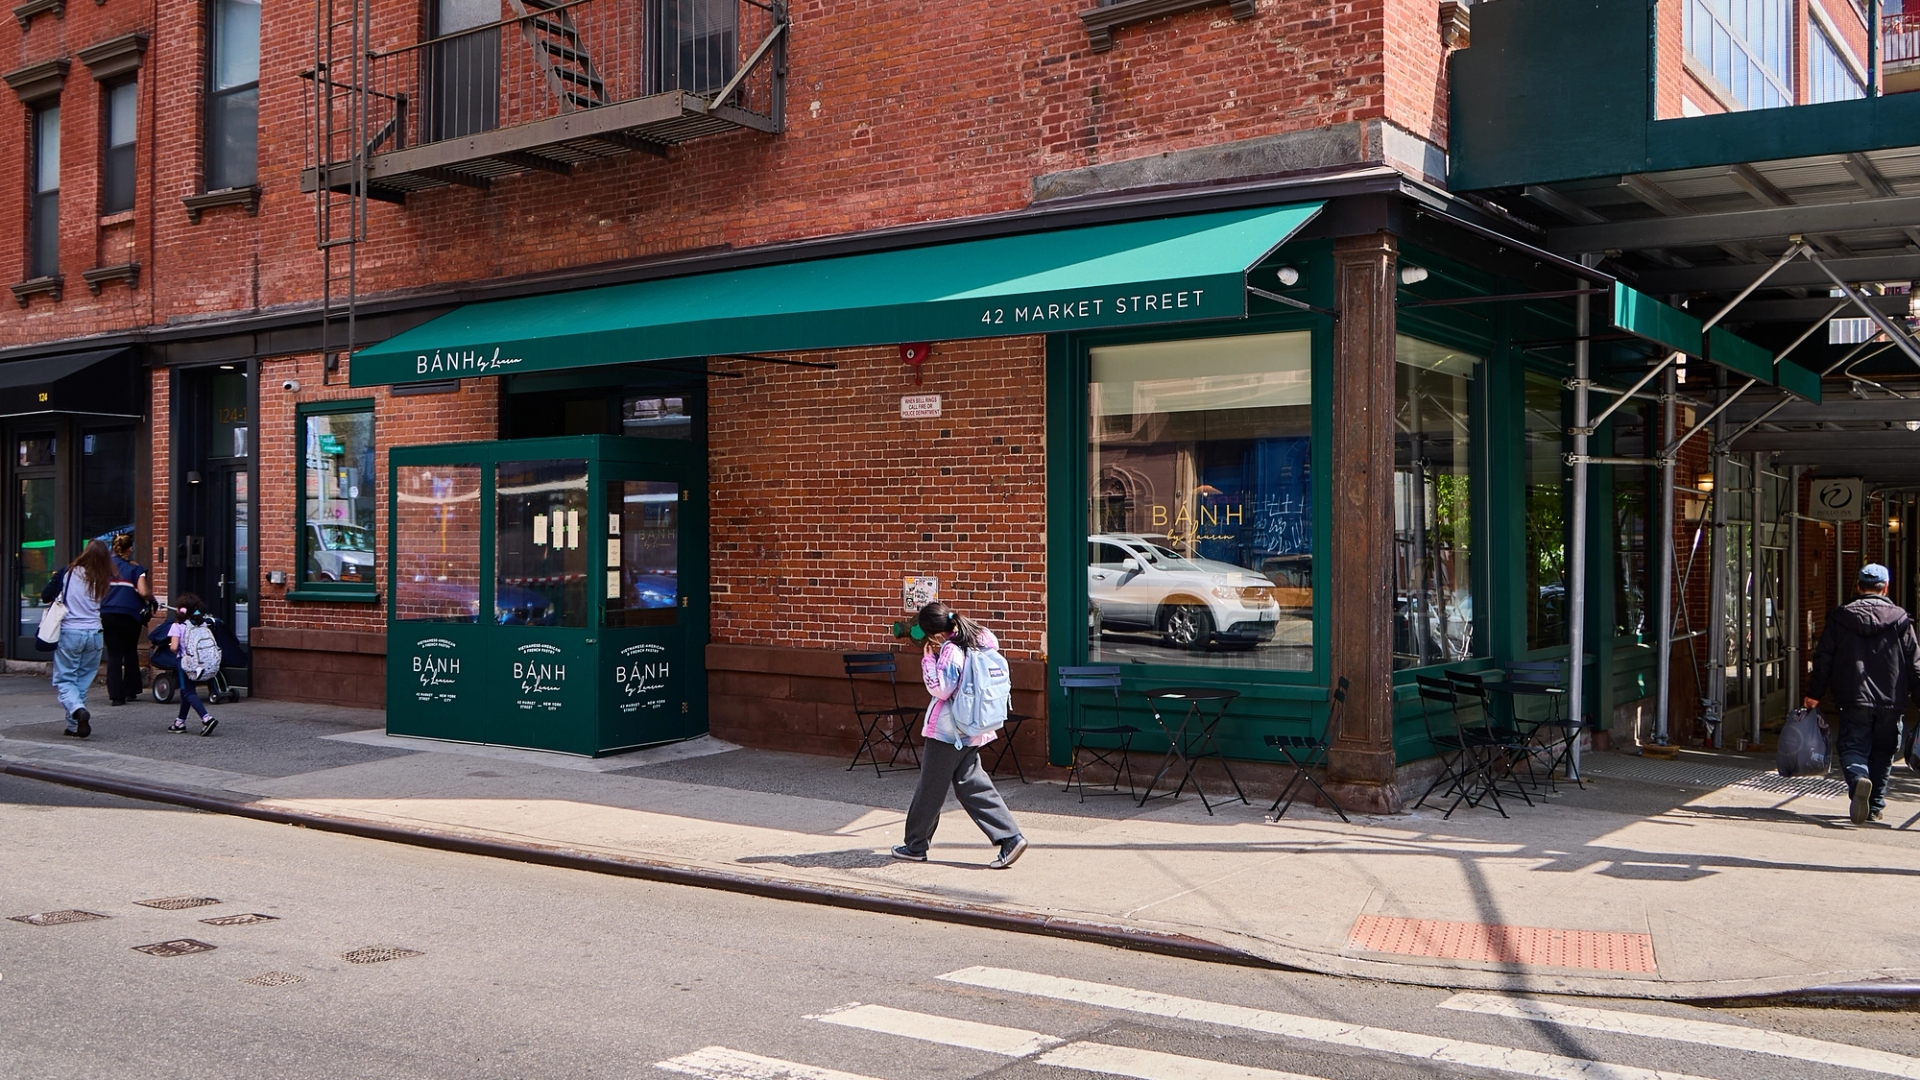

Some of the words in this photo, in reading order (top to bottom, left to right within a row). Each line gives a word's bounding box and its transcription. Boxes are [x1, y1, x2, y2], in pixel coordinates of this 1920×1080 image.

[981, 309, 1004, 324] 42
[1015, 299, 1104, 322] MARKET
[1116, 290, 1204, 314] STREET
[416, 350, 475, 374] BÁNH
[477, 356, 490, 372] by
[38, 392, 48, 402] 124
[1152, 500, 1242, 526] BÁNH
[1166, 528, 1183, 546] by
[1188, 520, 1235, 544] Lauren
[412, 654, 460, 674] BÁNH
[513, 660, 566, 681] BÁNH
[616, 661, 669, 683] BÁNH
[420, 674, 430, 686] by
[521, 680, 532, 694] by
[625, 683, 636, 697] by
